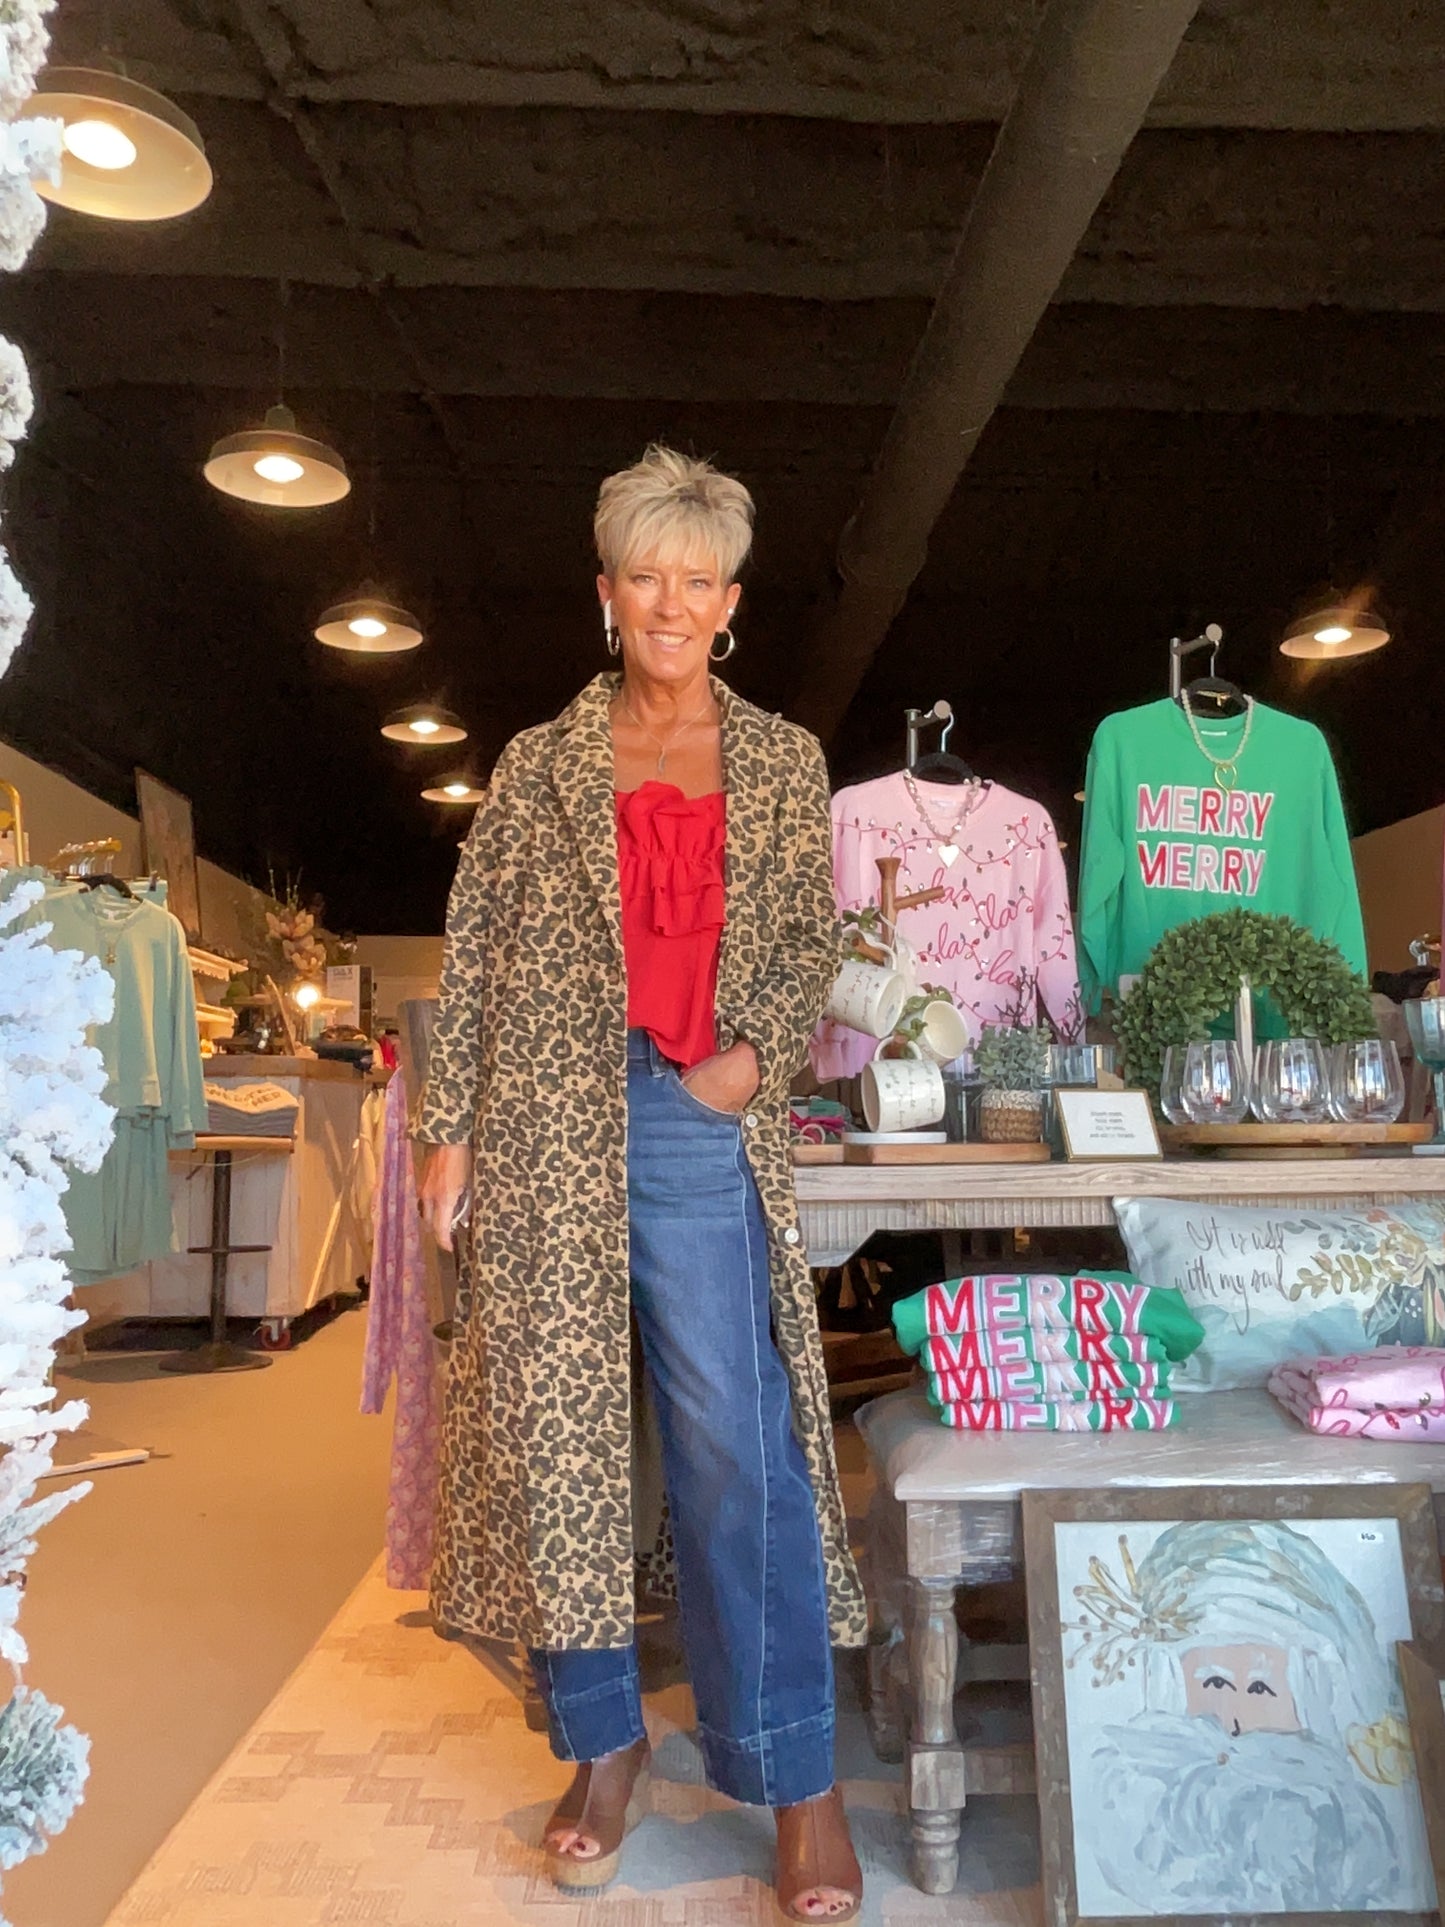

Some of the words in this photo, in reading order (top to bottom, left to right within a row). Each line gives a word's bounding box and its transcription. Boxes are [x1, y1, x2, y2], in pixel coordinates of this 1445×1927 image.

[1135, 784, 1274, 840] MERRY
[1136, 840, 1266, 896] MERRY
[985, 893, 1018, 930] la
[937, 922, 965, 959] la
[987, 949, 1020, 986] la
[1185, 1216, 1224, 1256] It
[1230, 1229, 1246, 1255] is
[1251, 1219, 1288, 1255] well
[925, 1275, 1151, 1336] MERRY
[1174, 1255, 1219, 1299] with
[1219, 1273, 1250, 1336] my
[1250, 1254, 1292, 1301] soul
